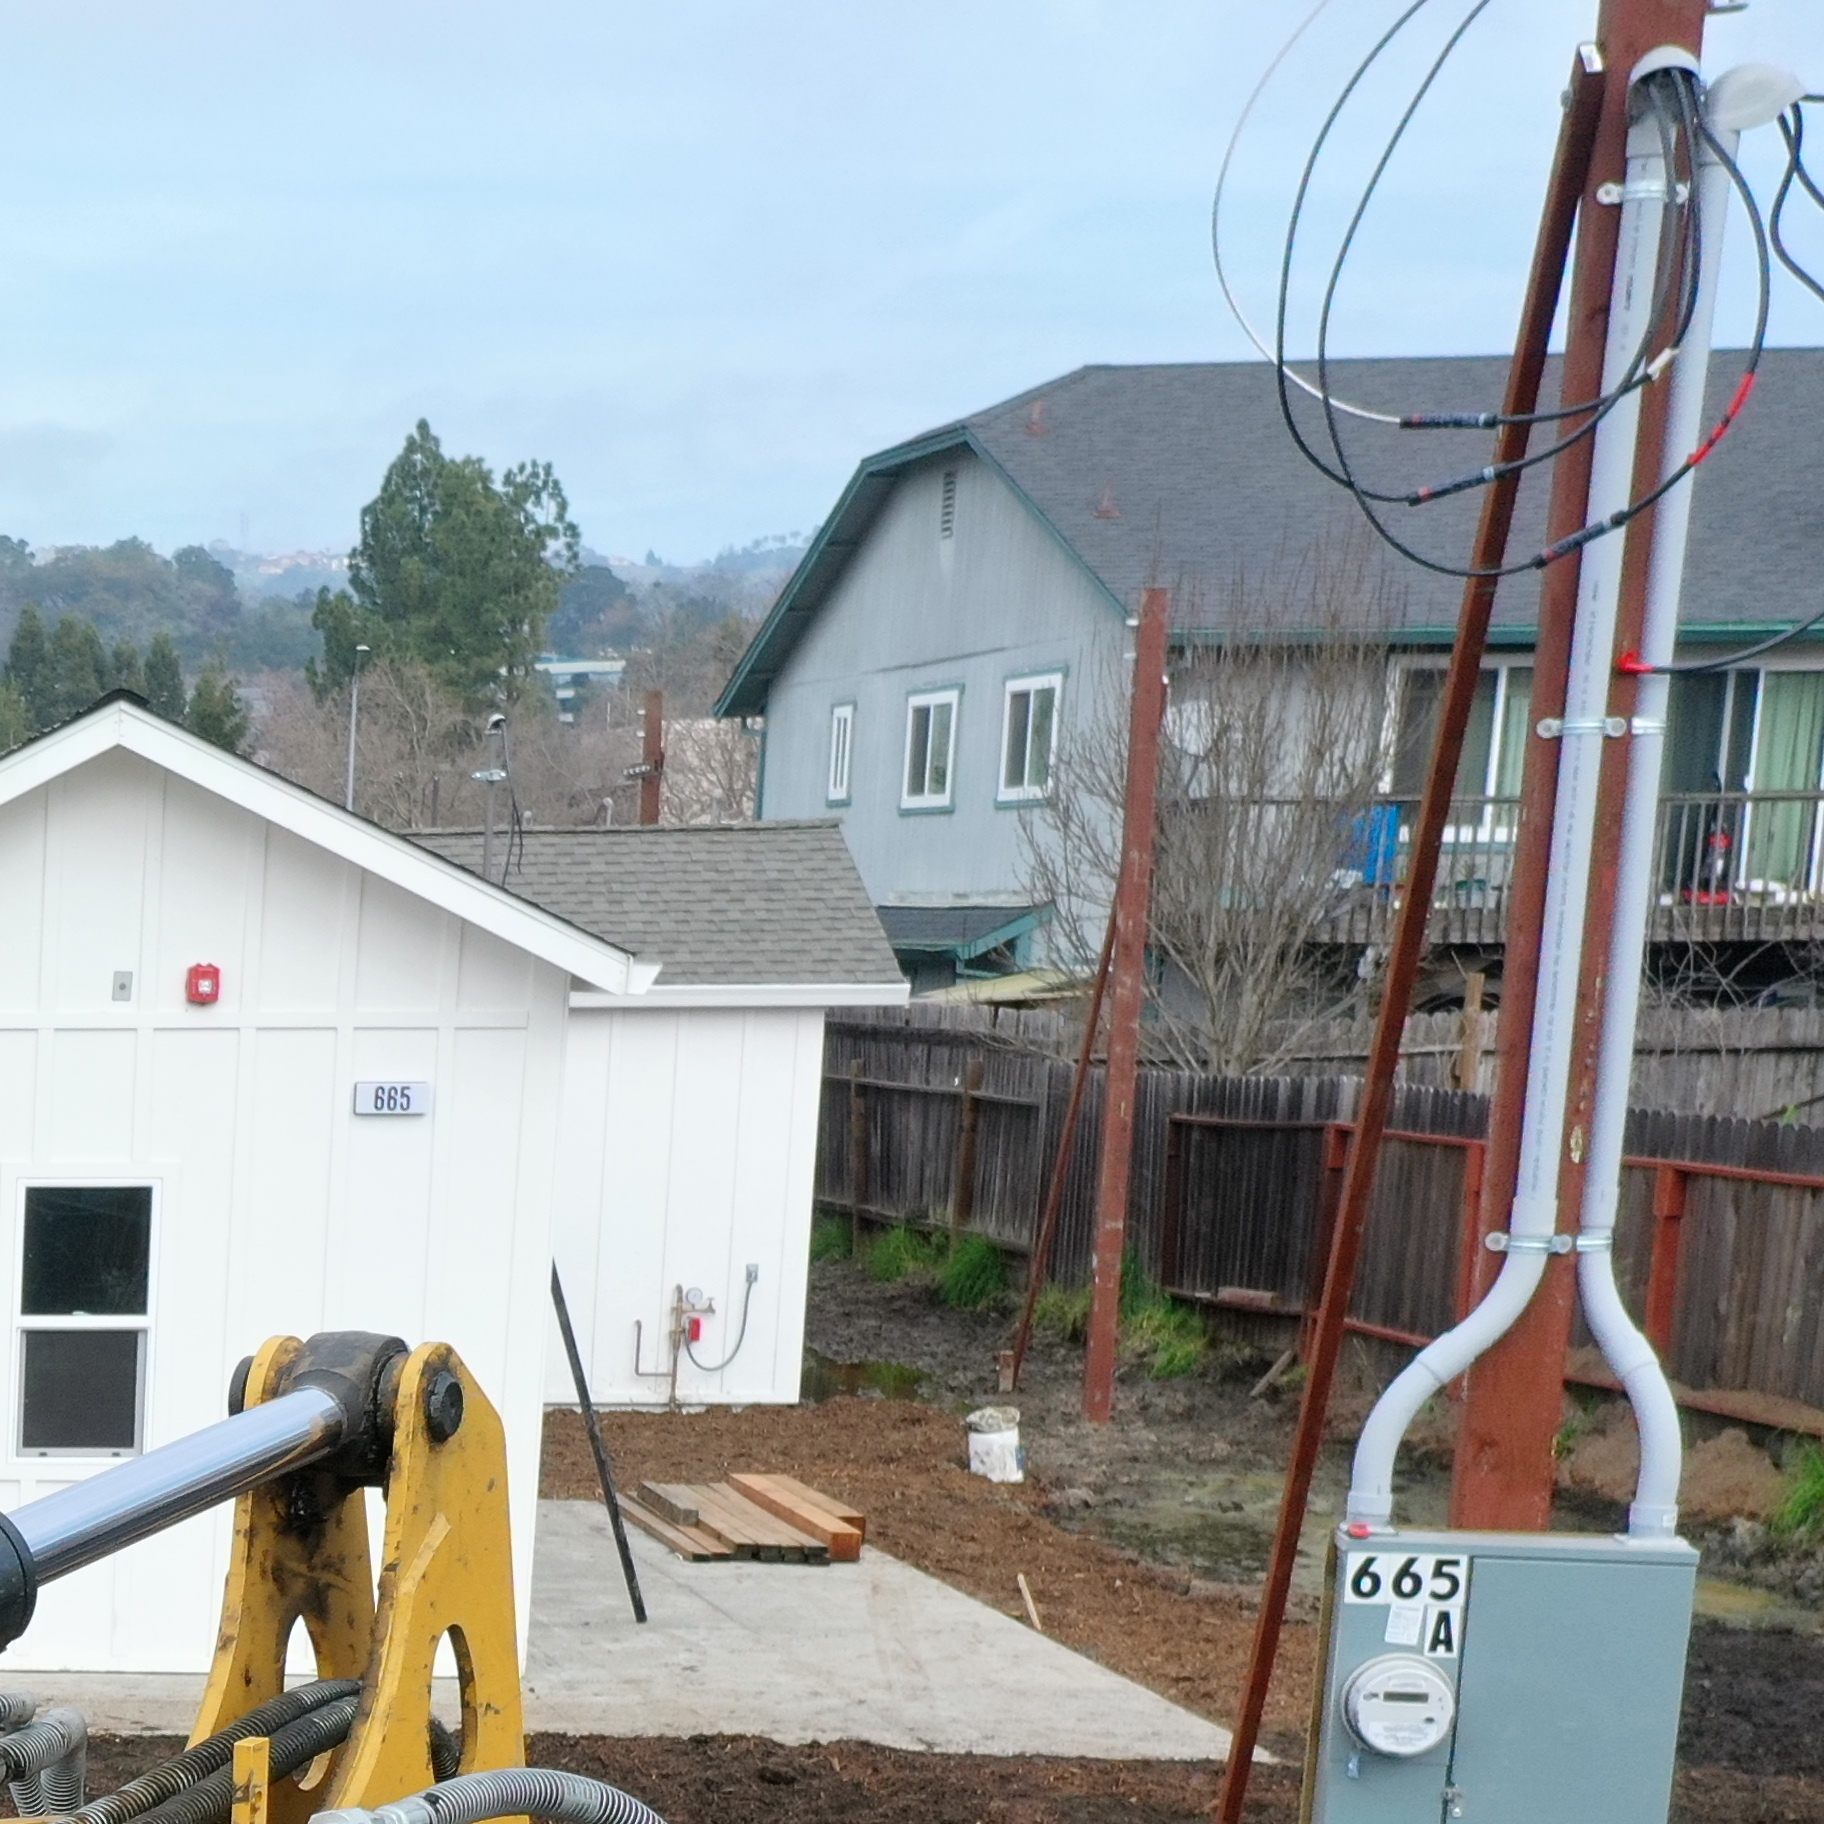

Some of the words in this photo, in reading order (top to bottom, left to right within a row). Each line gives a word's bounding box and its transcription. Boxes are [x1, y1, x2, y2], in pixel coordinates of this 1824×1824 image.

[374, 1086, 411, 1111] 665
[1351, 1556, 1460, 1601] 665
[1428, 1610, 1453, 1654] A
